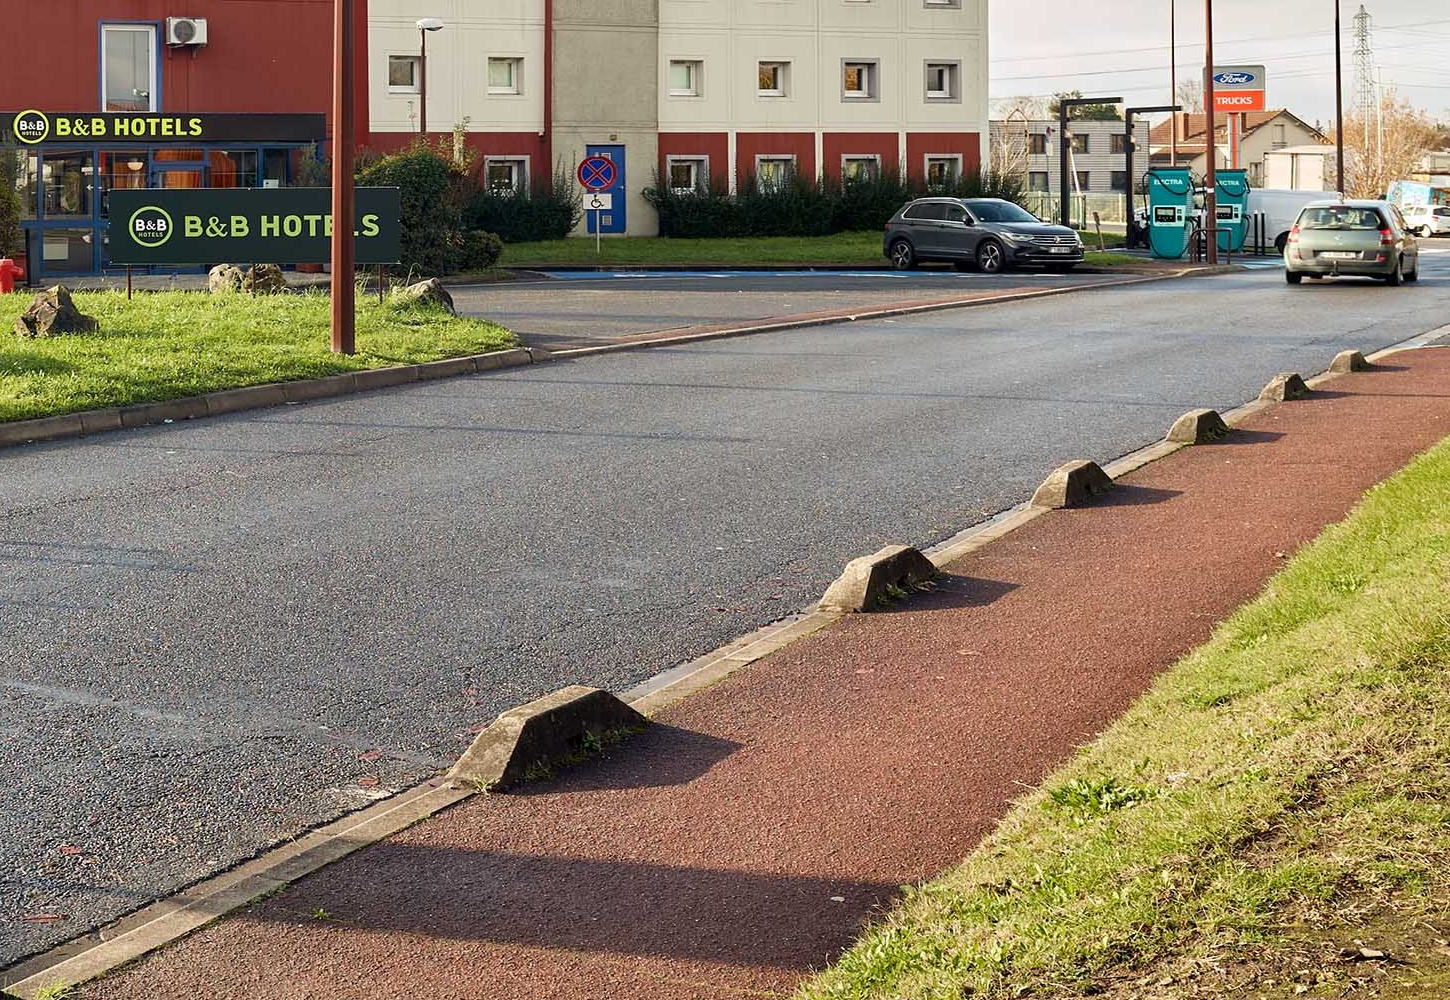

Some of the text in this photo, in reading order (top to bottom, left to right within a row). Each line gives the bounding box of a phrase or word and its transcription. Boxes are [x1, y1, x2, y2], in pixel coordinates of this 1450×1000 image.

[1220, 71, 1248, 84] Ford
[1215, 96, 1254, 105] TRUCKS
[19, 120, 45, 131] B&B
[56, 117, 203, 137] B&B HOTELS
[135, 219, 167, 232] B&B
[184, 214, 380, 238] B&B HOTES
